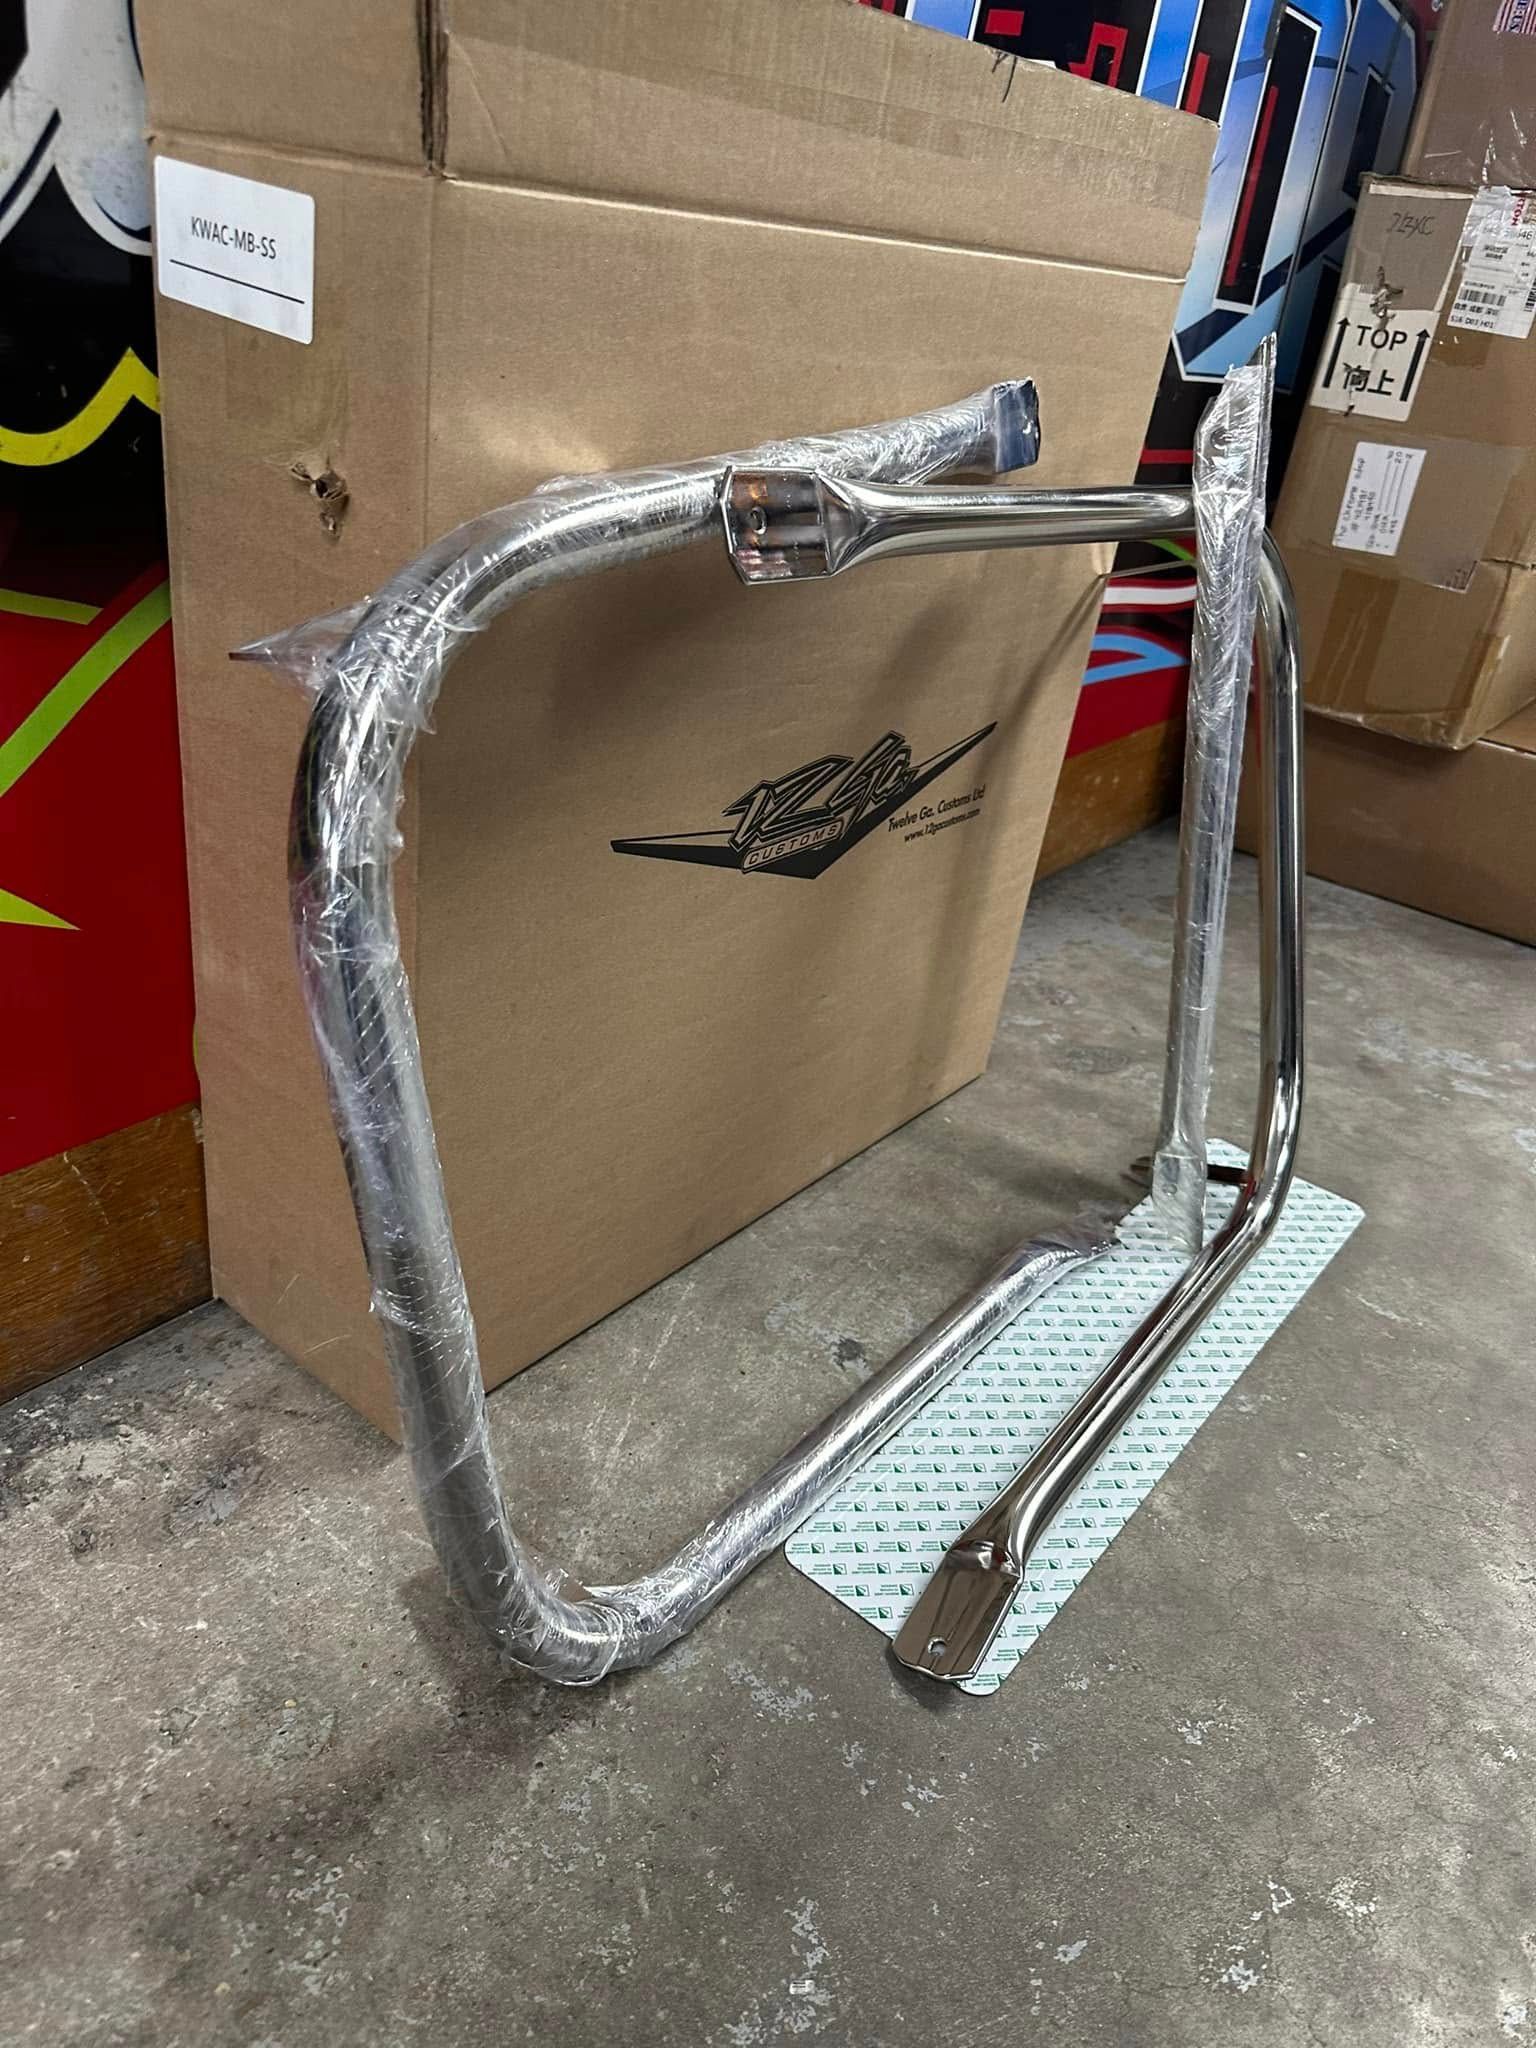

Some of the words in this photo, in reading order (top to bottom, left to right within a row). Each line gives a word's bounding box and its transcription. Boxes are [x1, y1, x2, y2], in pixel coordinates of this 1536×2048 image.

[191, 216, 277, 260] KWAC-MB-SS
[1357, 325, 1408, 351] TOP
[888, 810, 918, 832] Twelve
[937, 792, 972, 814] Customs
[972, 783, 986, 801] Ltd
[748, 824, 840, 867] CUSTOMS
